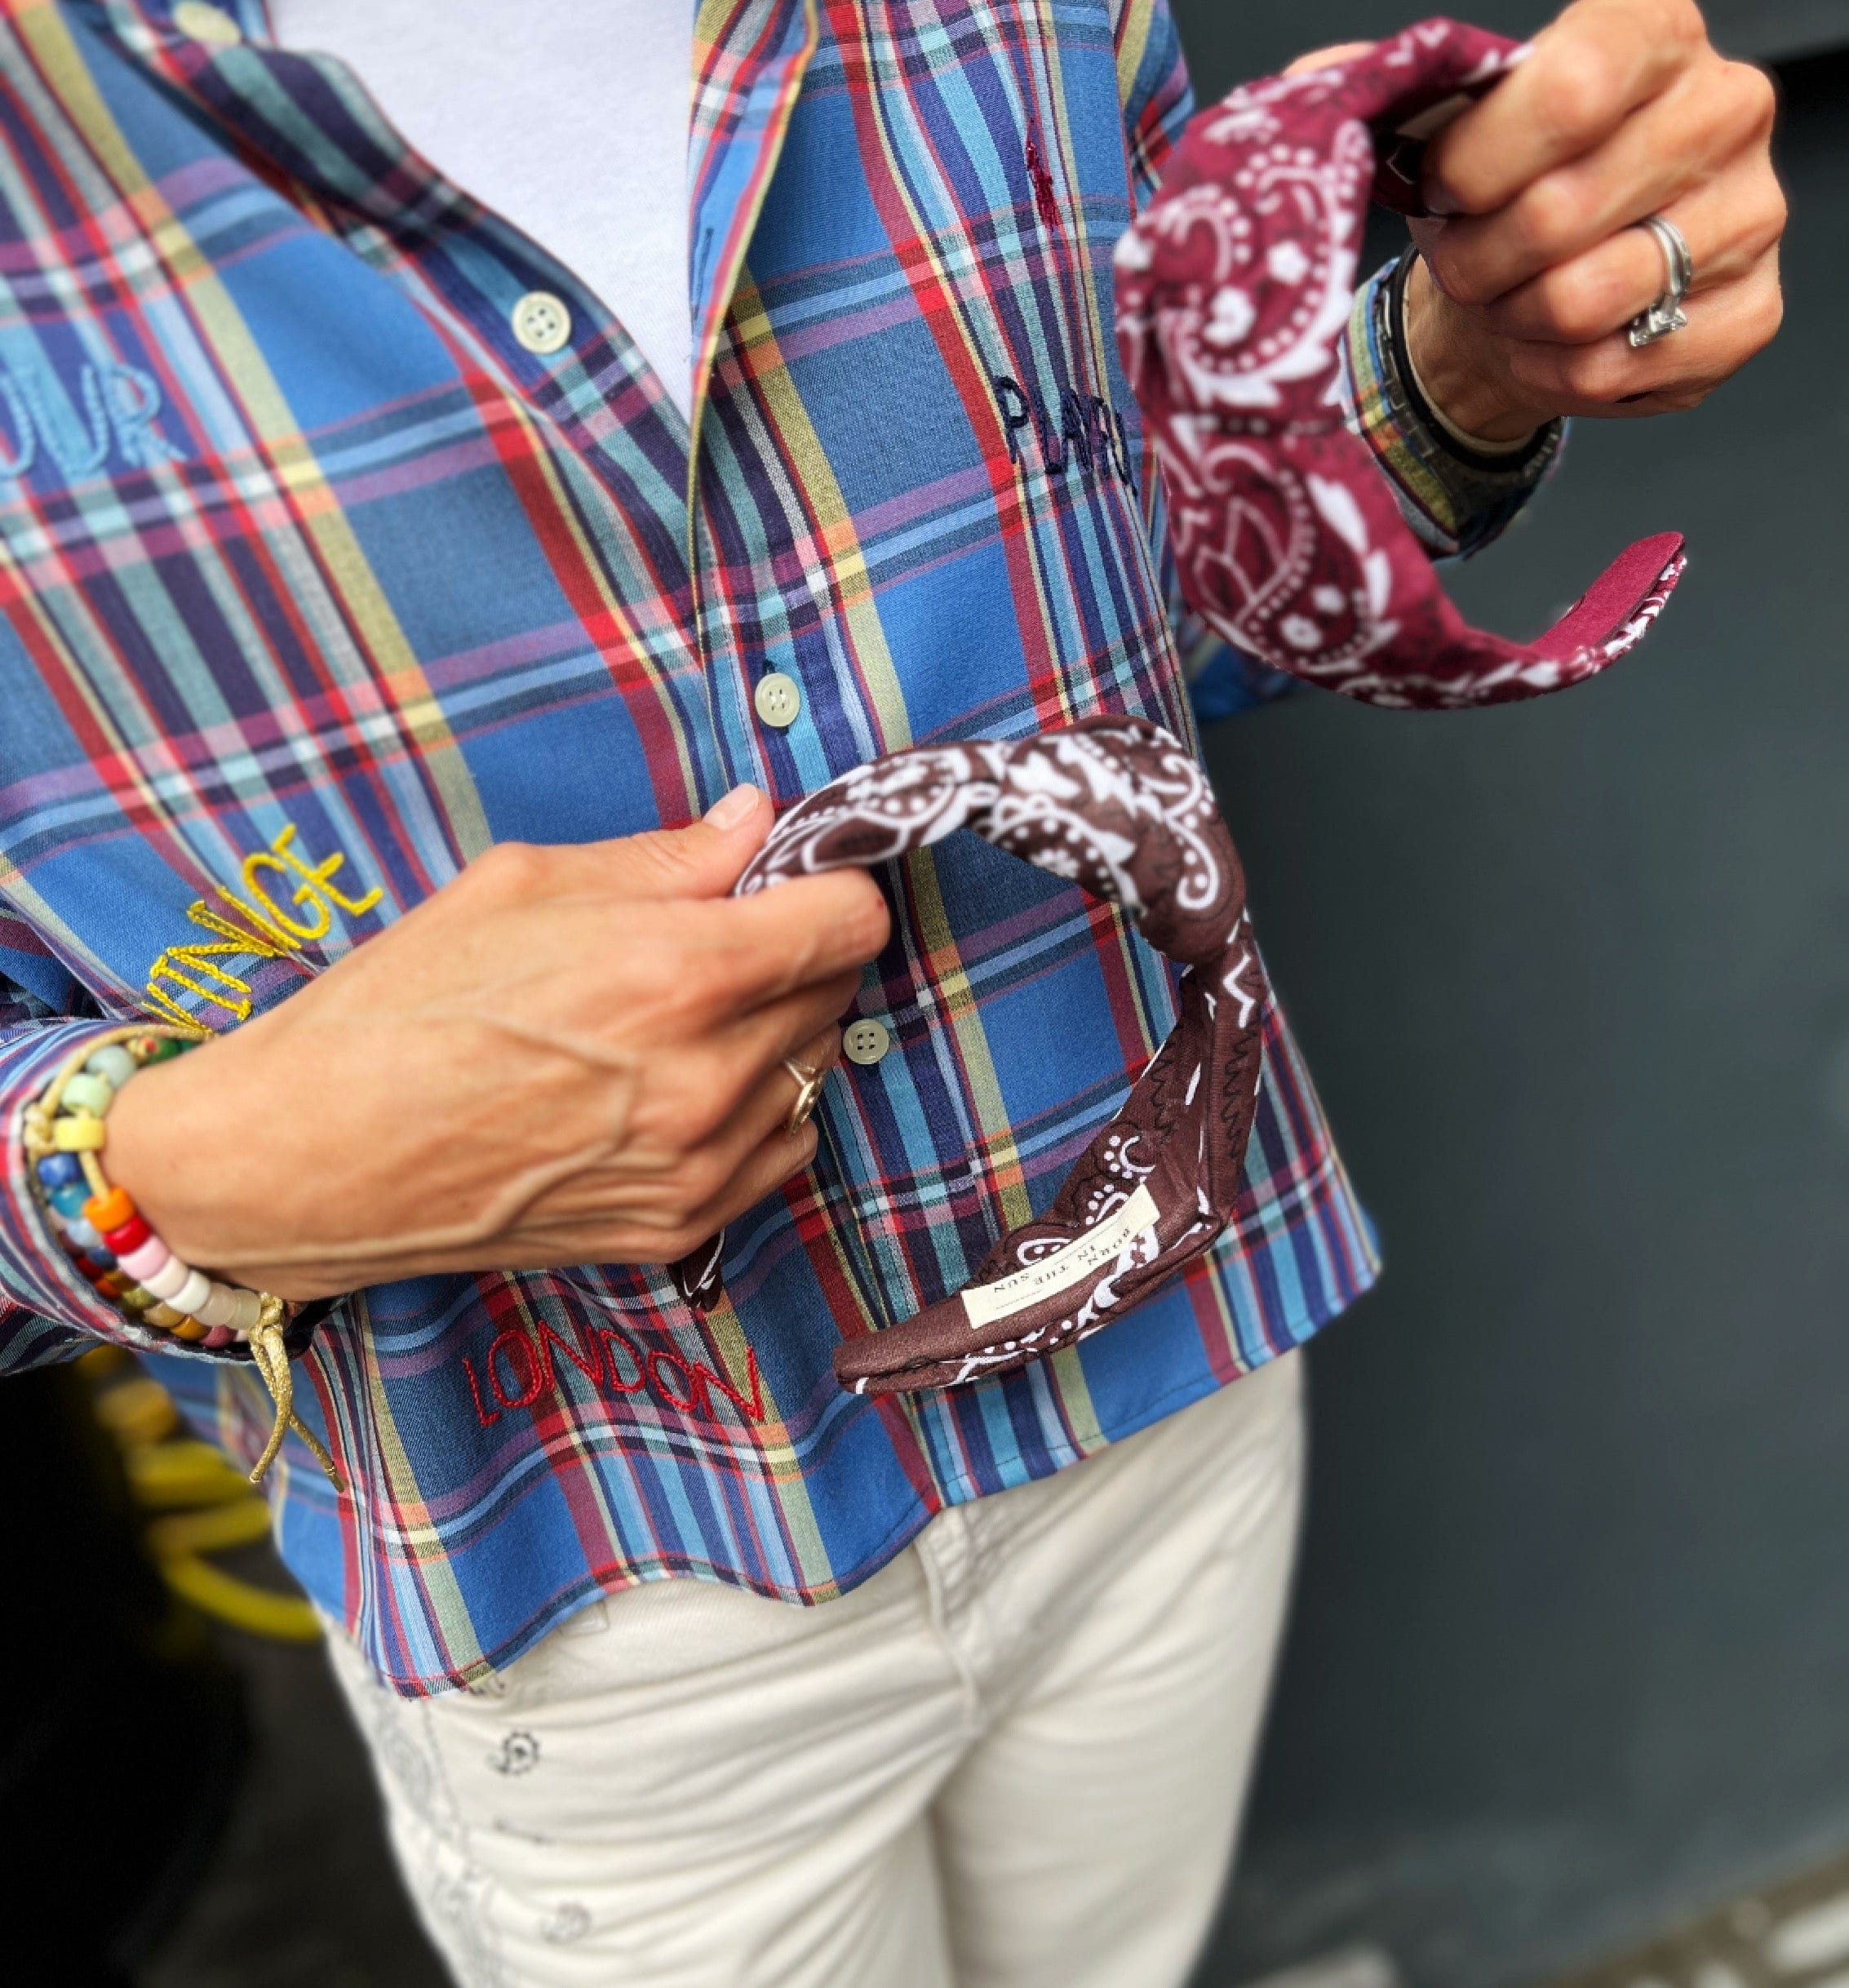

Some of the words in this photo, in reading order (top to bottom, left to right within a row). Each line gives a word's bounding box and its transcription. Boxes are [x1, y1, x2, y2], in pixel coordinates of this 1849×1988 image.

[1077, 1245, 1096, 1262] IN
[1087, 1227, 1131, 1266] BORN
[994, 1272, 1030, 1293] SUN
[1033, 1265, 1069, 1285] THE
[462, 1320, 765, 1427] LONDON
